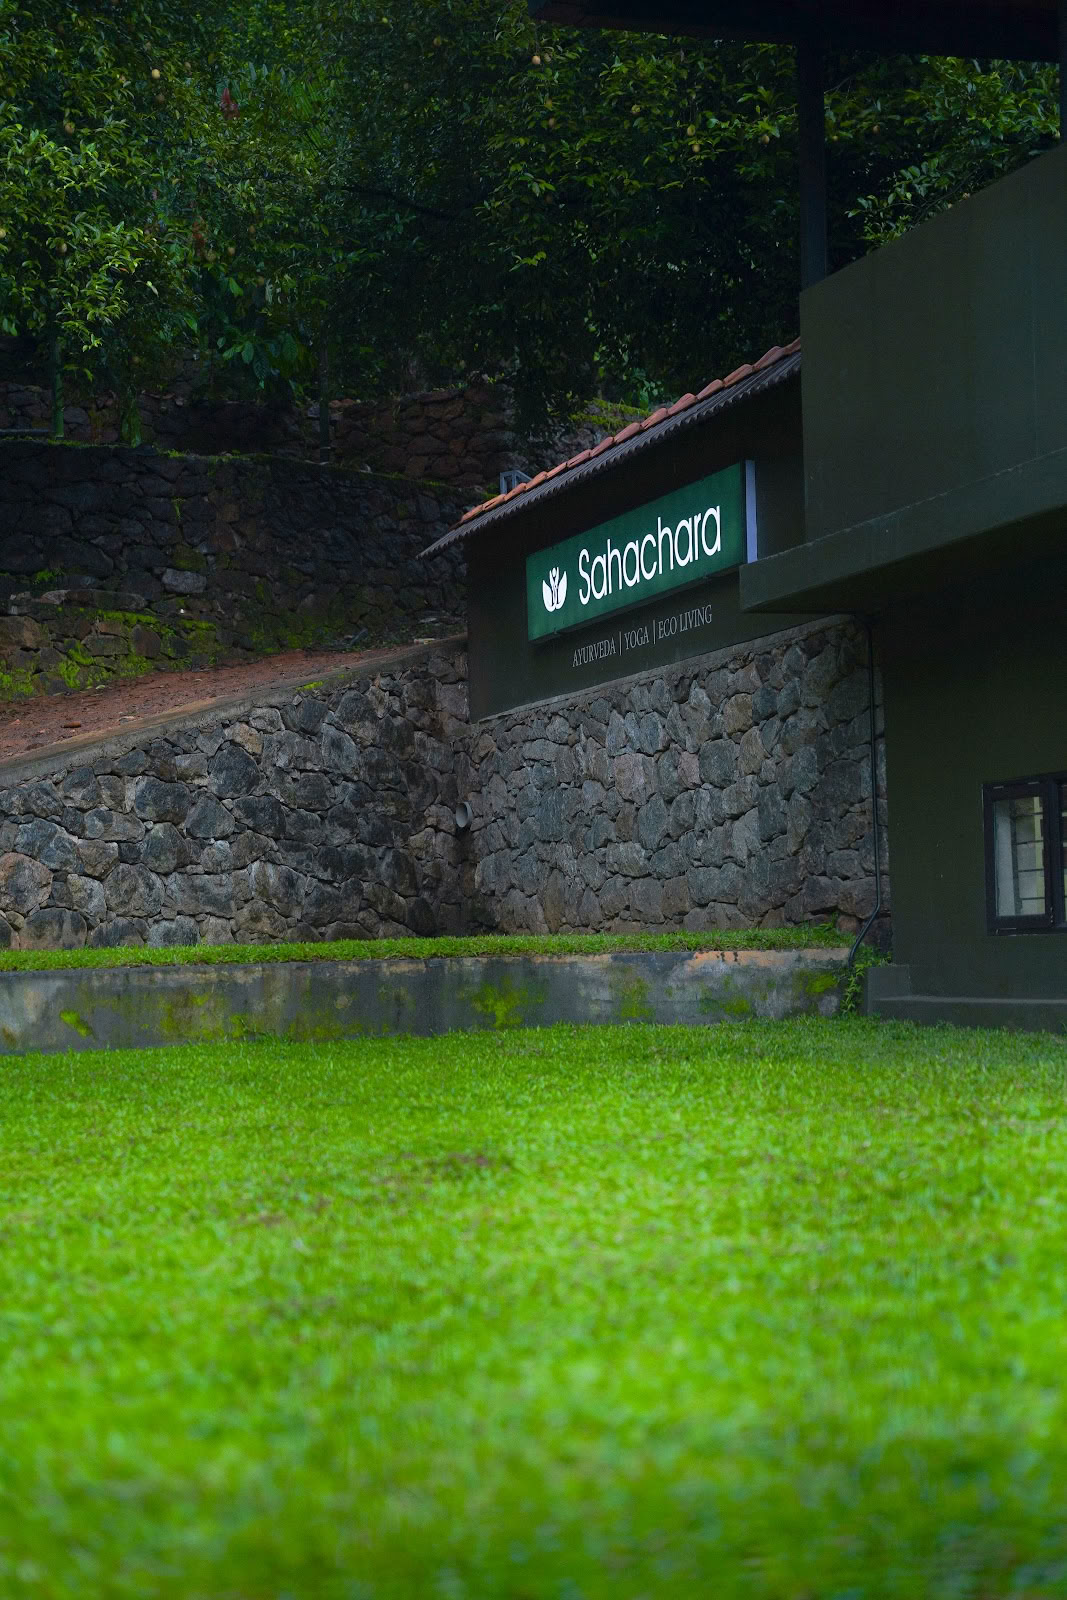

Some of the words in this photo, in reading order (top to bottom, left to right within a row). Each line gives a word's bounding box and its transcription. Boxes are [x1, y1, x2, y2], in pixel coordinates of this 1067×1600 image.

[578, 505, 721, 605] Sahachara
[572, 637, 616, 667] AYURVEDA
[624, 626, 649, 650] YOGA
[658, 616, 677, 639] ECO
[679, 605, 712, 632] LIVING
